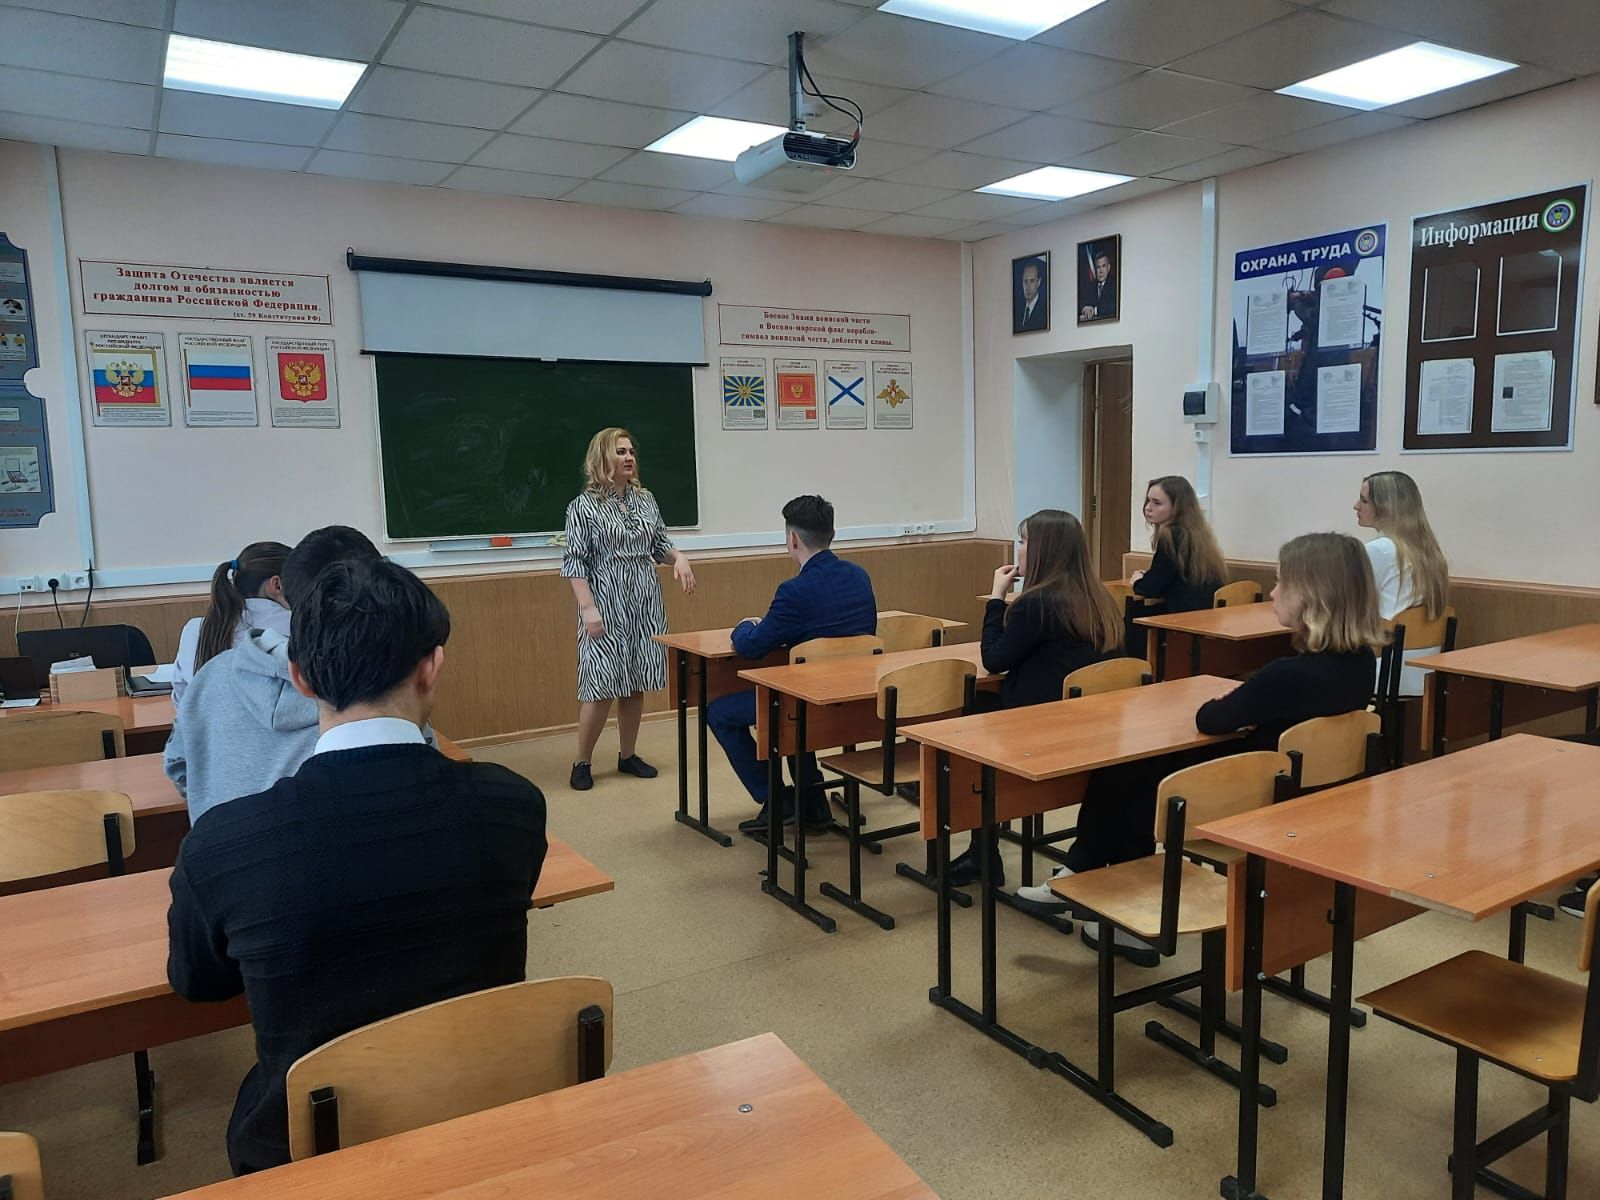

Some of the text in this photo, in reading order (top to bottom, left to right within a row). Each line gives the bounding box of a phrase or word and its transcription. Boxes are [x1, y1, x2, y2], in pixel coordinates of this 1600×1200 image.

[1420, 213, 1540, 248] Информация
[1240, 242, 1351, 273] ОХРАНА ТРУДА
[116, 267, 294, 287] Защита Отечества является
[133, 282, 281, 298] долгом и обязанностью
[93, 292, 322, 312] гражданина Российской Федерации.
